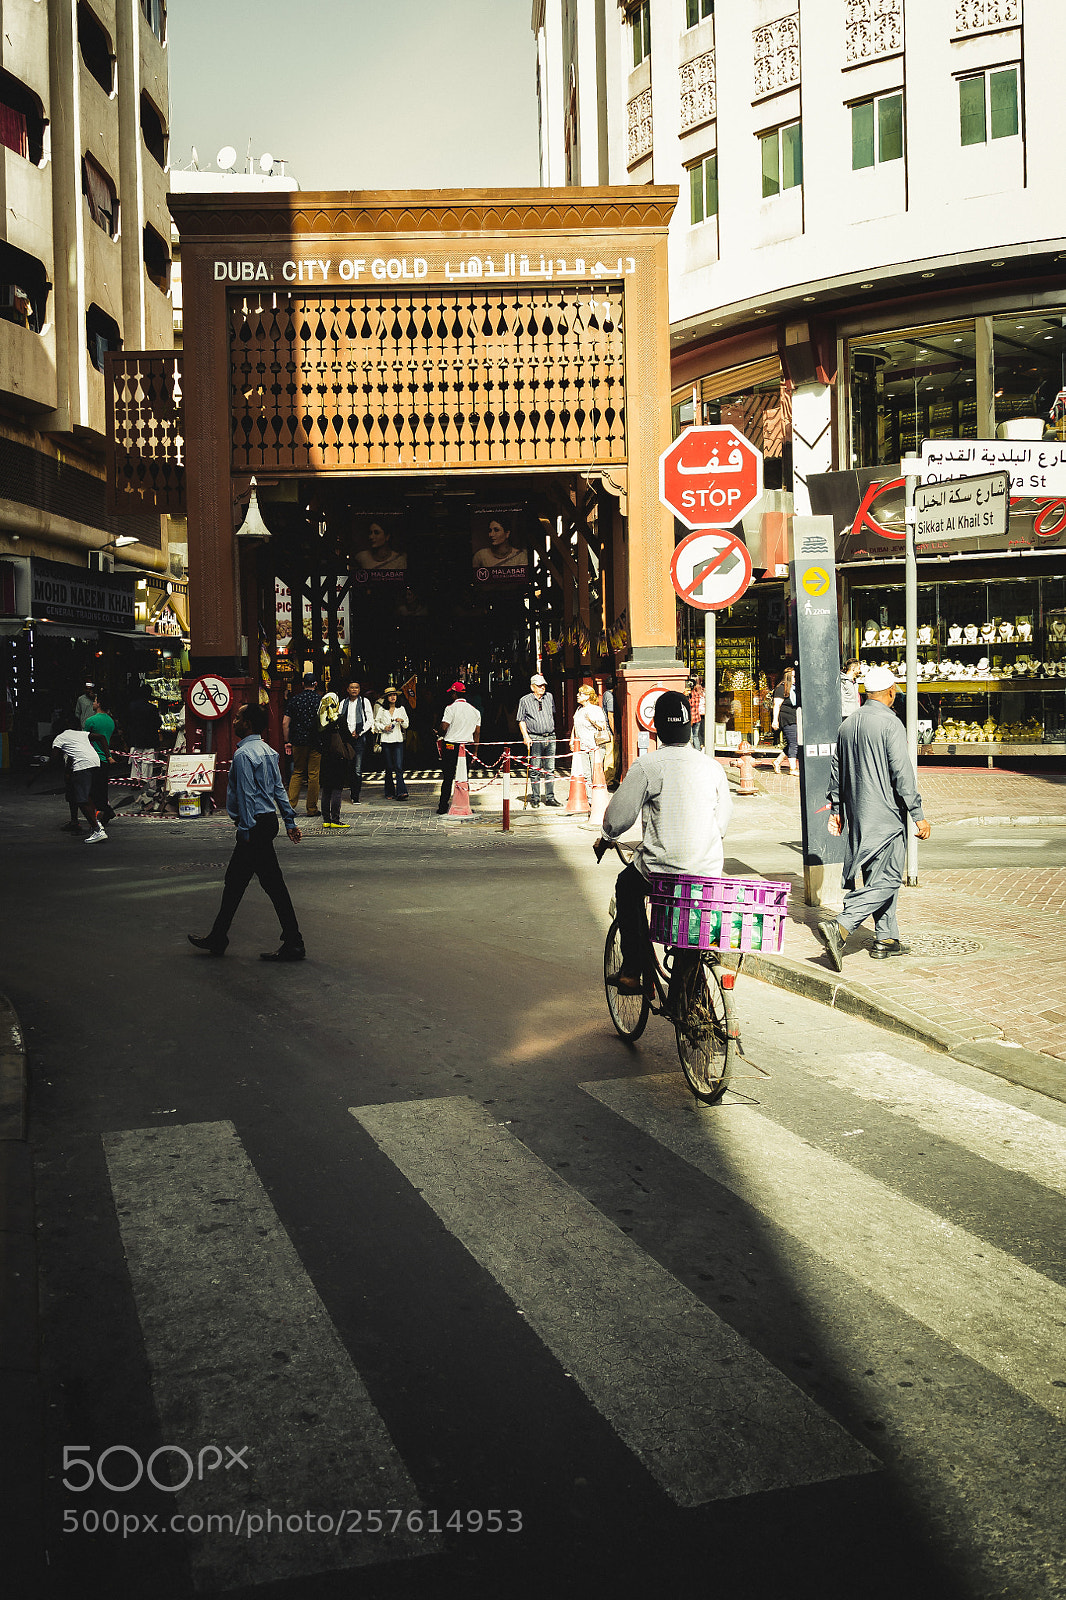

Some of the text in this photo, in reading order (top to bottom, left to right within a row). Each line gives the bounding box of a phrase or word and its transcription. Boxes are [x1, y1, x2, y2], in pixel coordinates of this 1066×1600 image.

[214, 258, 428, 281] DUBA CITY OF GOLD
[444, 252, 636, 282] دبي مدينة الذهب
[677, 439, 744, 476] قف
[927, 448, 1066, 468] ارع البلدية القديم
[975, 480, 1006, 505] شارع
[1029, 475, 1047, 488] St
[681, 488, 742, 508] STOP
[918, 488, 946, 513] الخيل
[948, 488, 972, 504] سكة
[917, 511, 994, 535] Sikkat Al Khail St
[491, 567, 526, 575] MALABAR
[34, 580, 67, 604] MOHD
[70, 586, 105, 609] NAEEM
[108, 593, 132, 614] KHAN
[46, 605, 74, 618] GENERAL
[76, 610, 101, 621] TRADING
